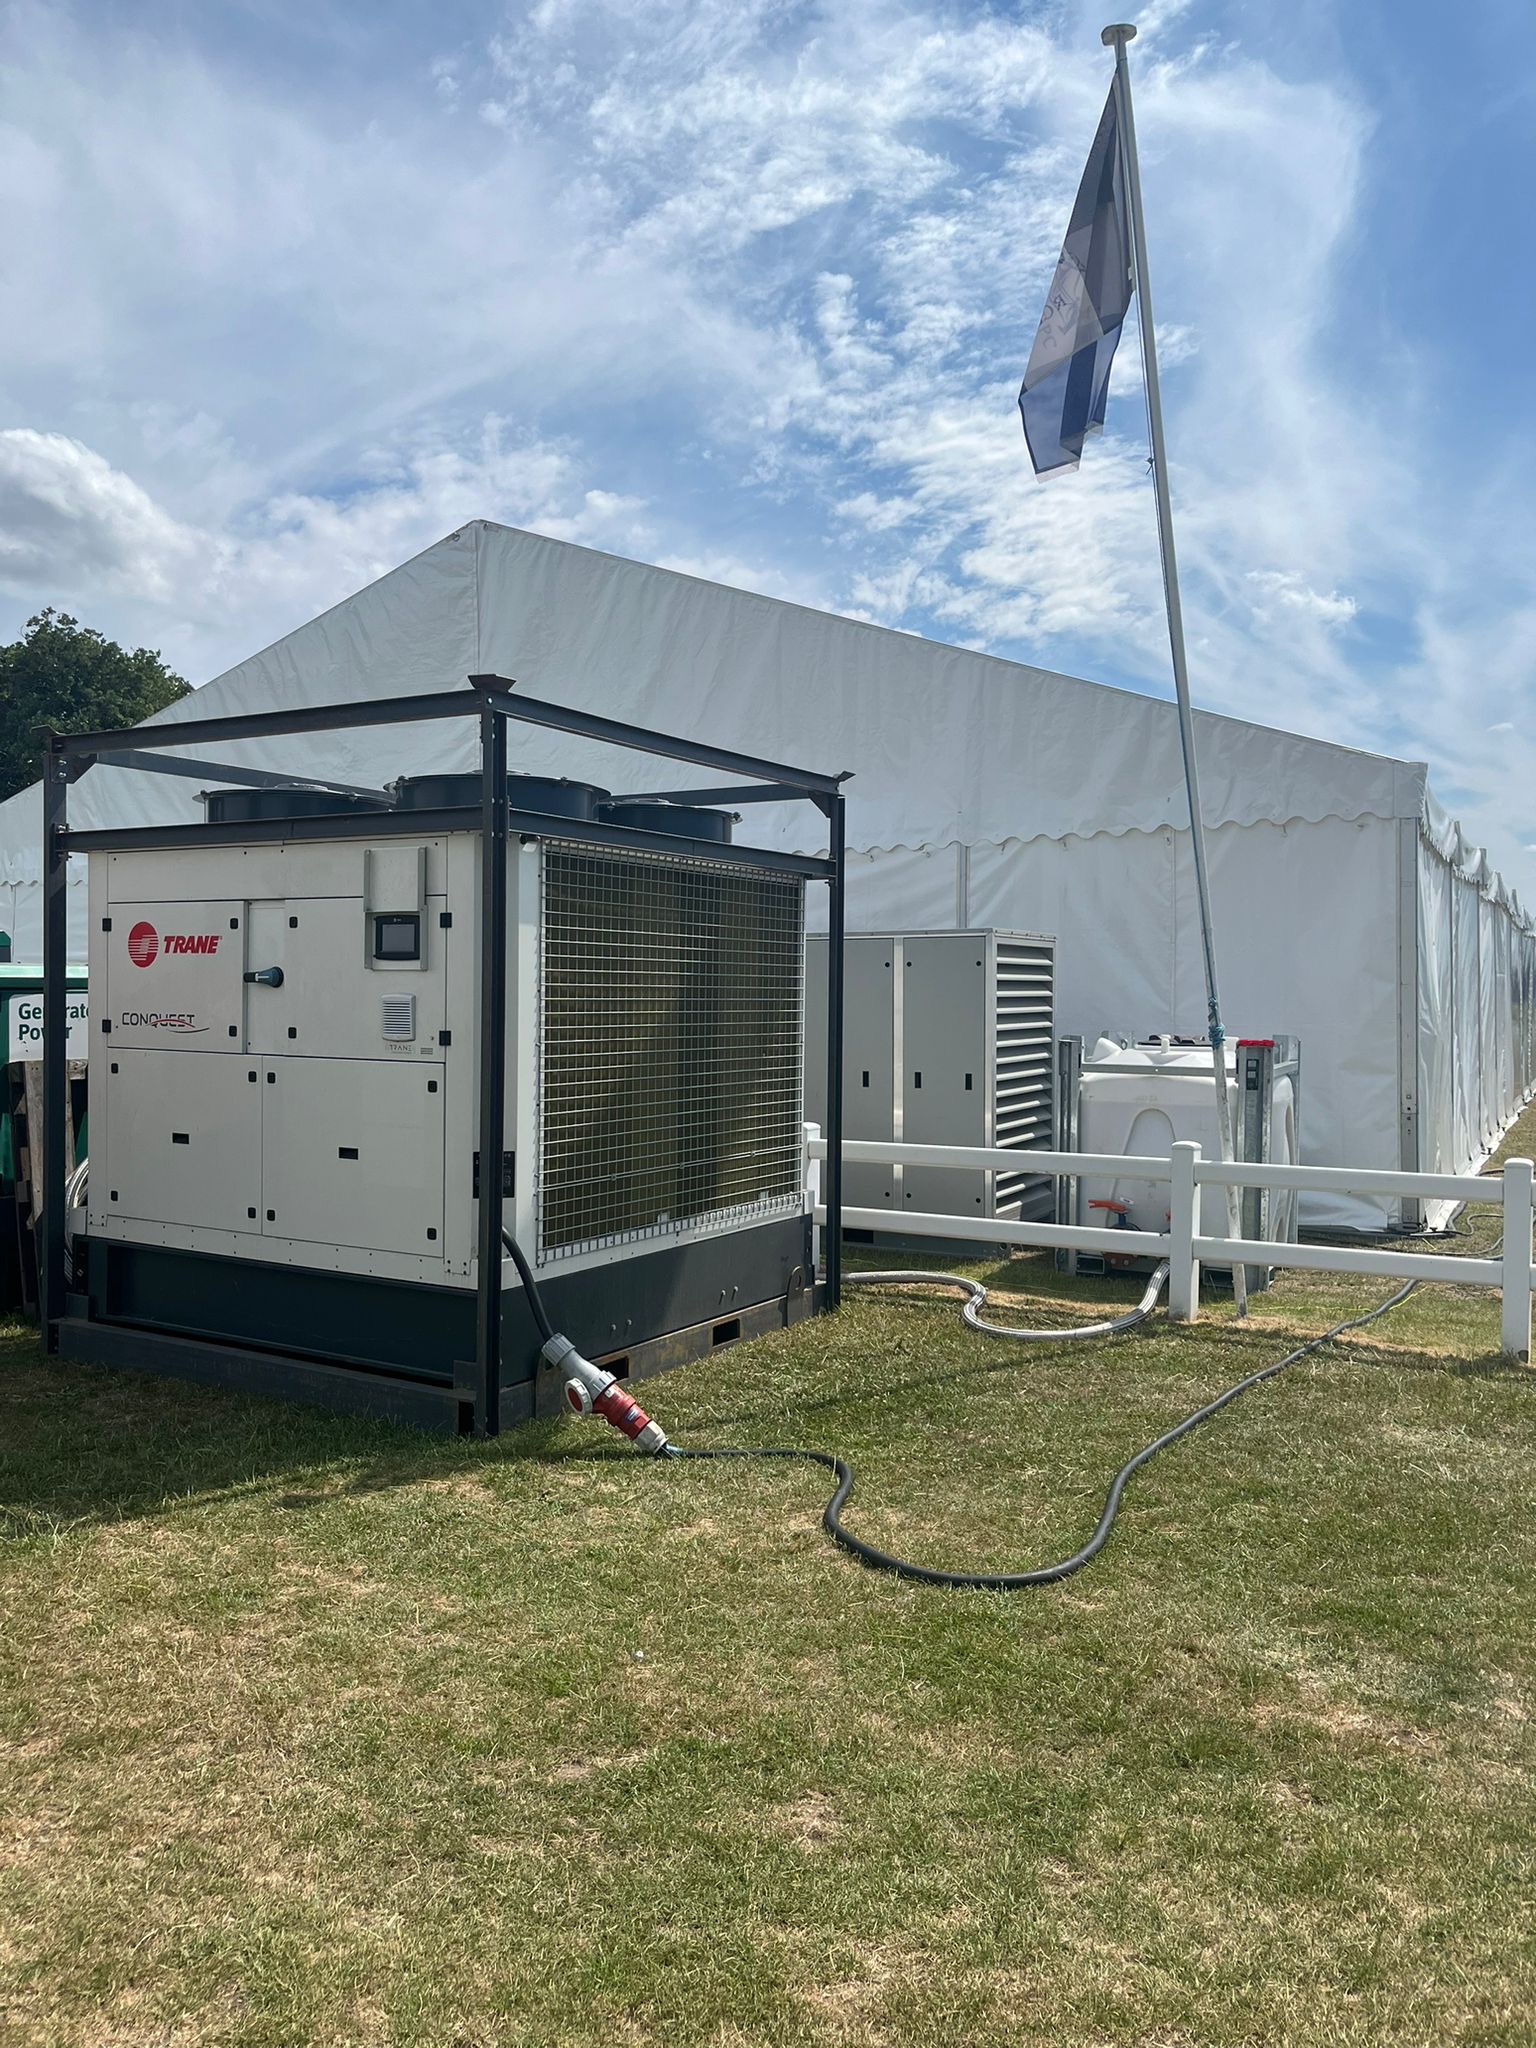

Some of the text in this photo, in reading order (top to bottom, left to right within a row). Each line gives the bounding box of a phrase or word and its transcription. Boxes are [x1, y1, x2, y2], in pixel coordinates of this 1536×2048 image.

[163, 935, 220, 954] TRANE
[122, 1012, 195, 1028] CONQUEST
[18, 1023, 72, 1041] Por
